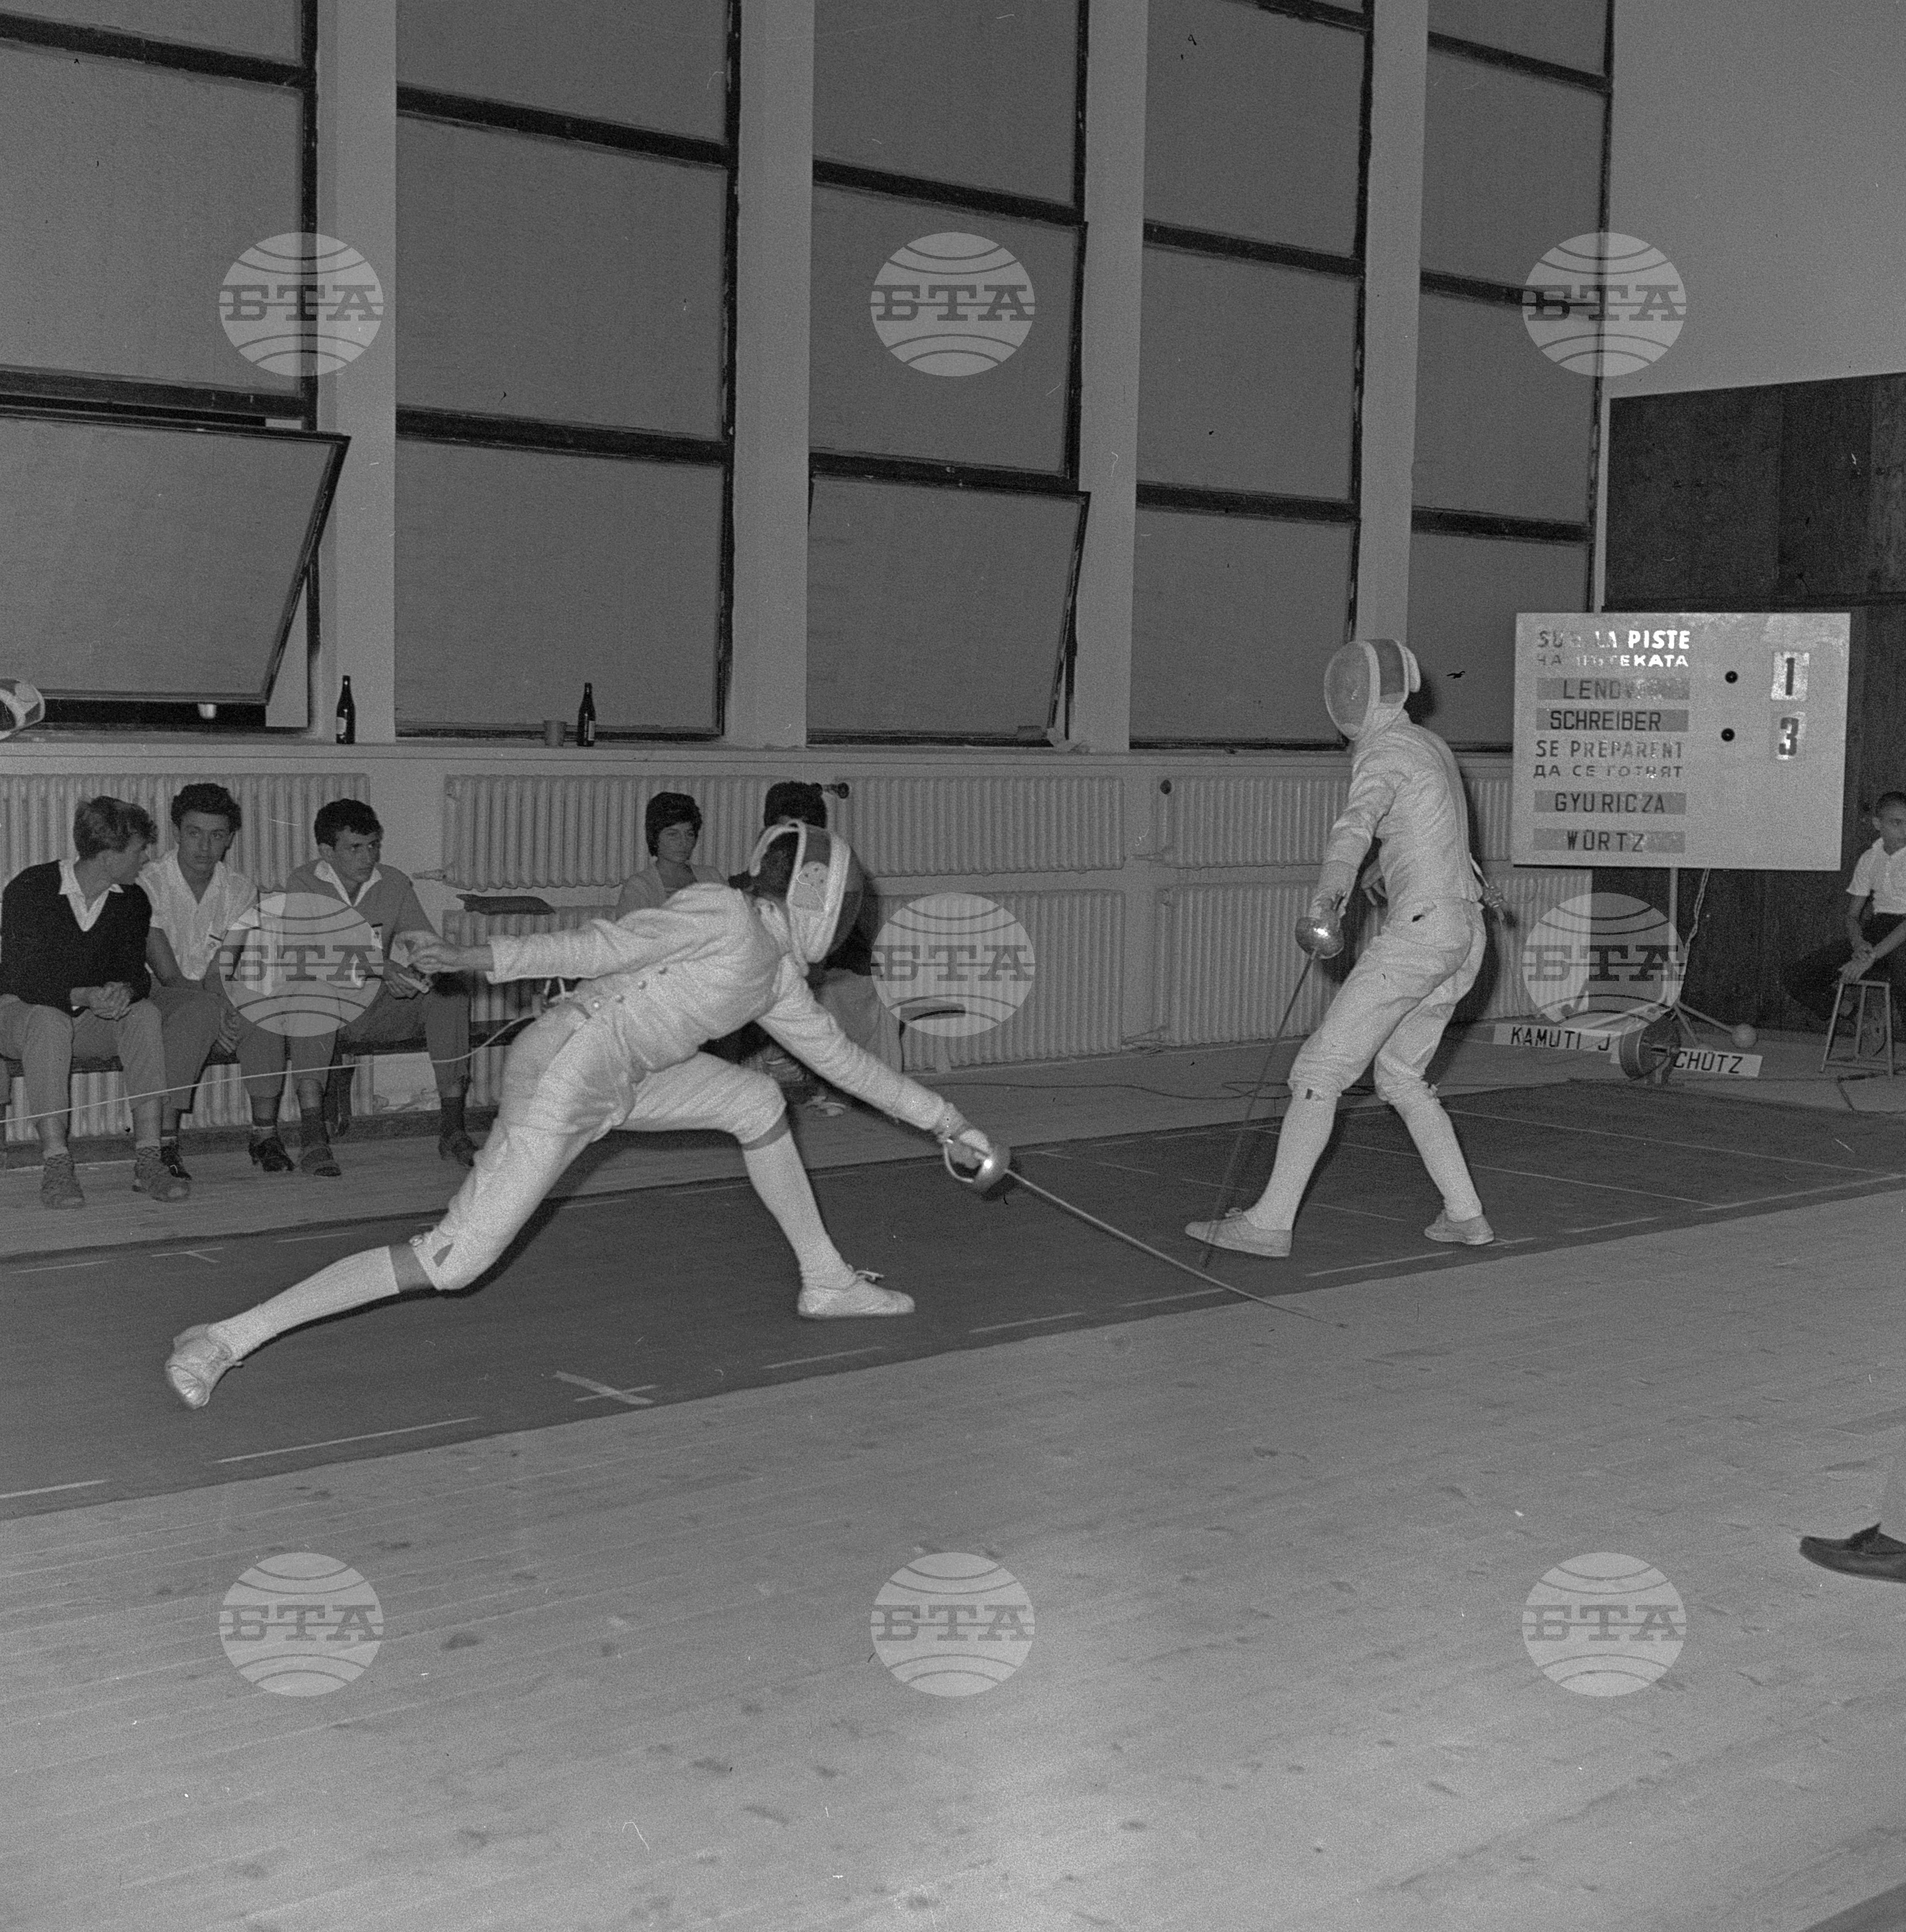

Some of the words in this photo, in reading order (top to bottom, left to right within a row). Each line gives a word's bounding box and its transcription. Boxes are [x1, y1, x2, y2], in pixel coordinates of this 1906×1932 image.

[1628, 630, 1690, 649] PISTE
[1786, 658, 1794, 695] 1
[1550, 710, 1661, 731] SCHREIBER
[1779, 717, 1799, 755] 3
[1536, 739, 1559, 757] SE
[1570, 740, 1683, 758] PREPARENT
[1534, 765, 1560, 778] ДА
[1573, 765, 1595, 776] СЕ
[1510, 1027, 1581, 1050] KAMUTI
[1598, 1033, 1611, 1051] J
[1674, 1051, 1743, 1074] CHÜTZ
